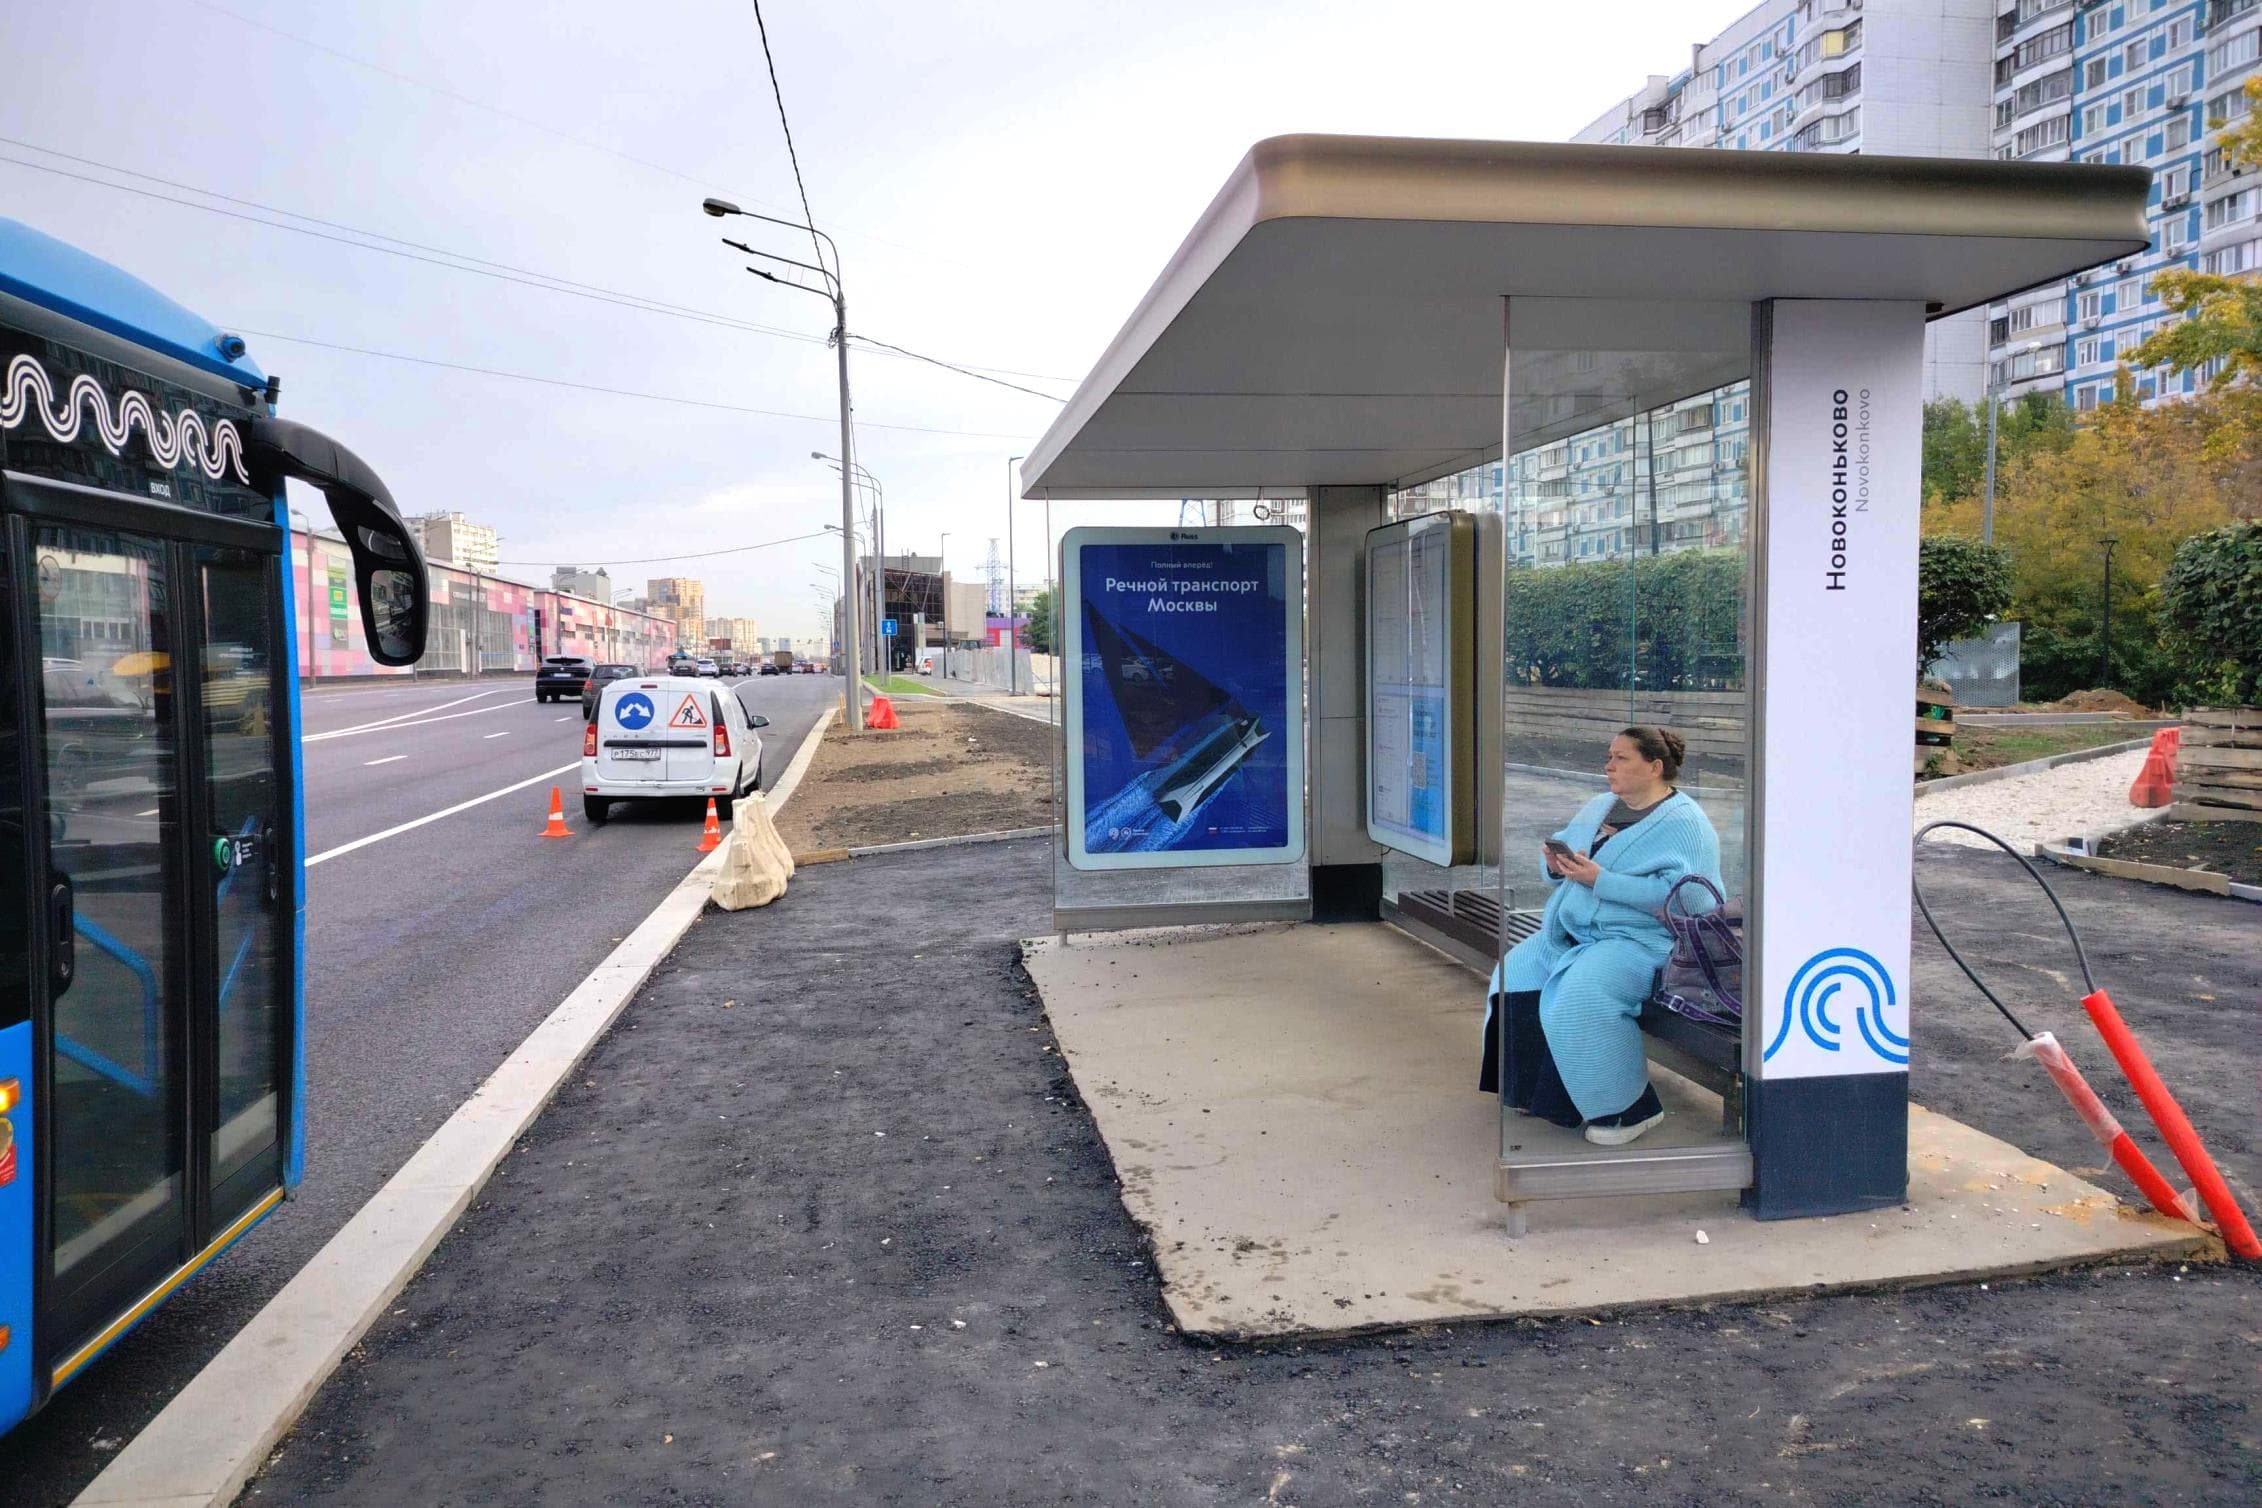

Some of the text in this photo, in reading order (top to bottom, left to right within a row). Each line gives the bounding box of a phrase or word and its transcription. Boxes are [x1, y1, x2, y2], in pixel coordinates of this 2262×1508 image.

[1855, 388, 1871, 513] Novokonkovo
[150, 482, 171, 498] ВХОД
[1826, 389, 1849, 590] Новоконьково
[1151, 561, 1181, 569] Полный
[1105, 577, 1259, 595] Речной транспорт
[1147, 598, 1217, 612] Москвы
